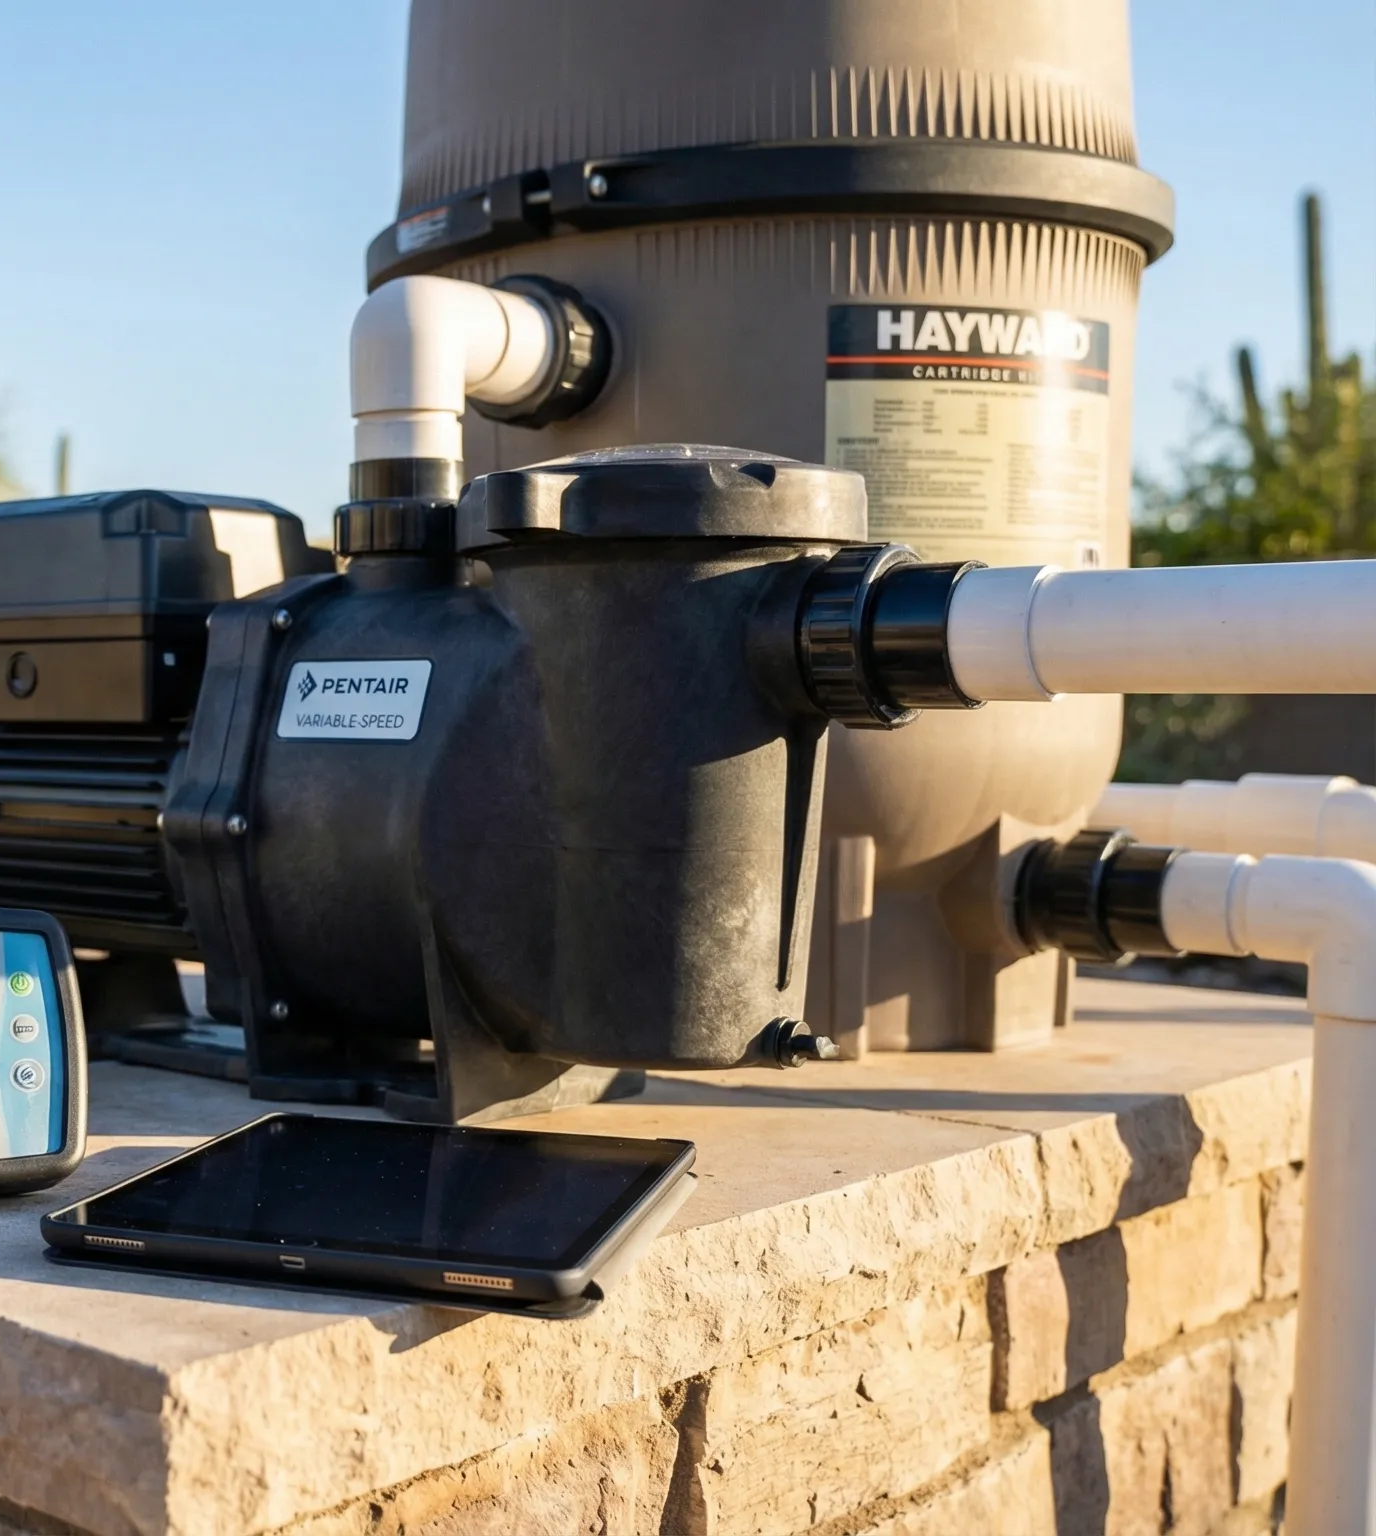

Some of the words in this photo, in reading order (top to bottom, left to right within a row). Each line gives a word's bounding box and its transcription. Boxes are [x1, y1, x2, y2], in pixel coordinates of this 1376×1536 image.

[877, 310, 1091, 360] HAYWAD
[321, 677, 409, 694] PENTAIR
[295, 713, 405, 729] VARIABLE-SPEED
